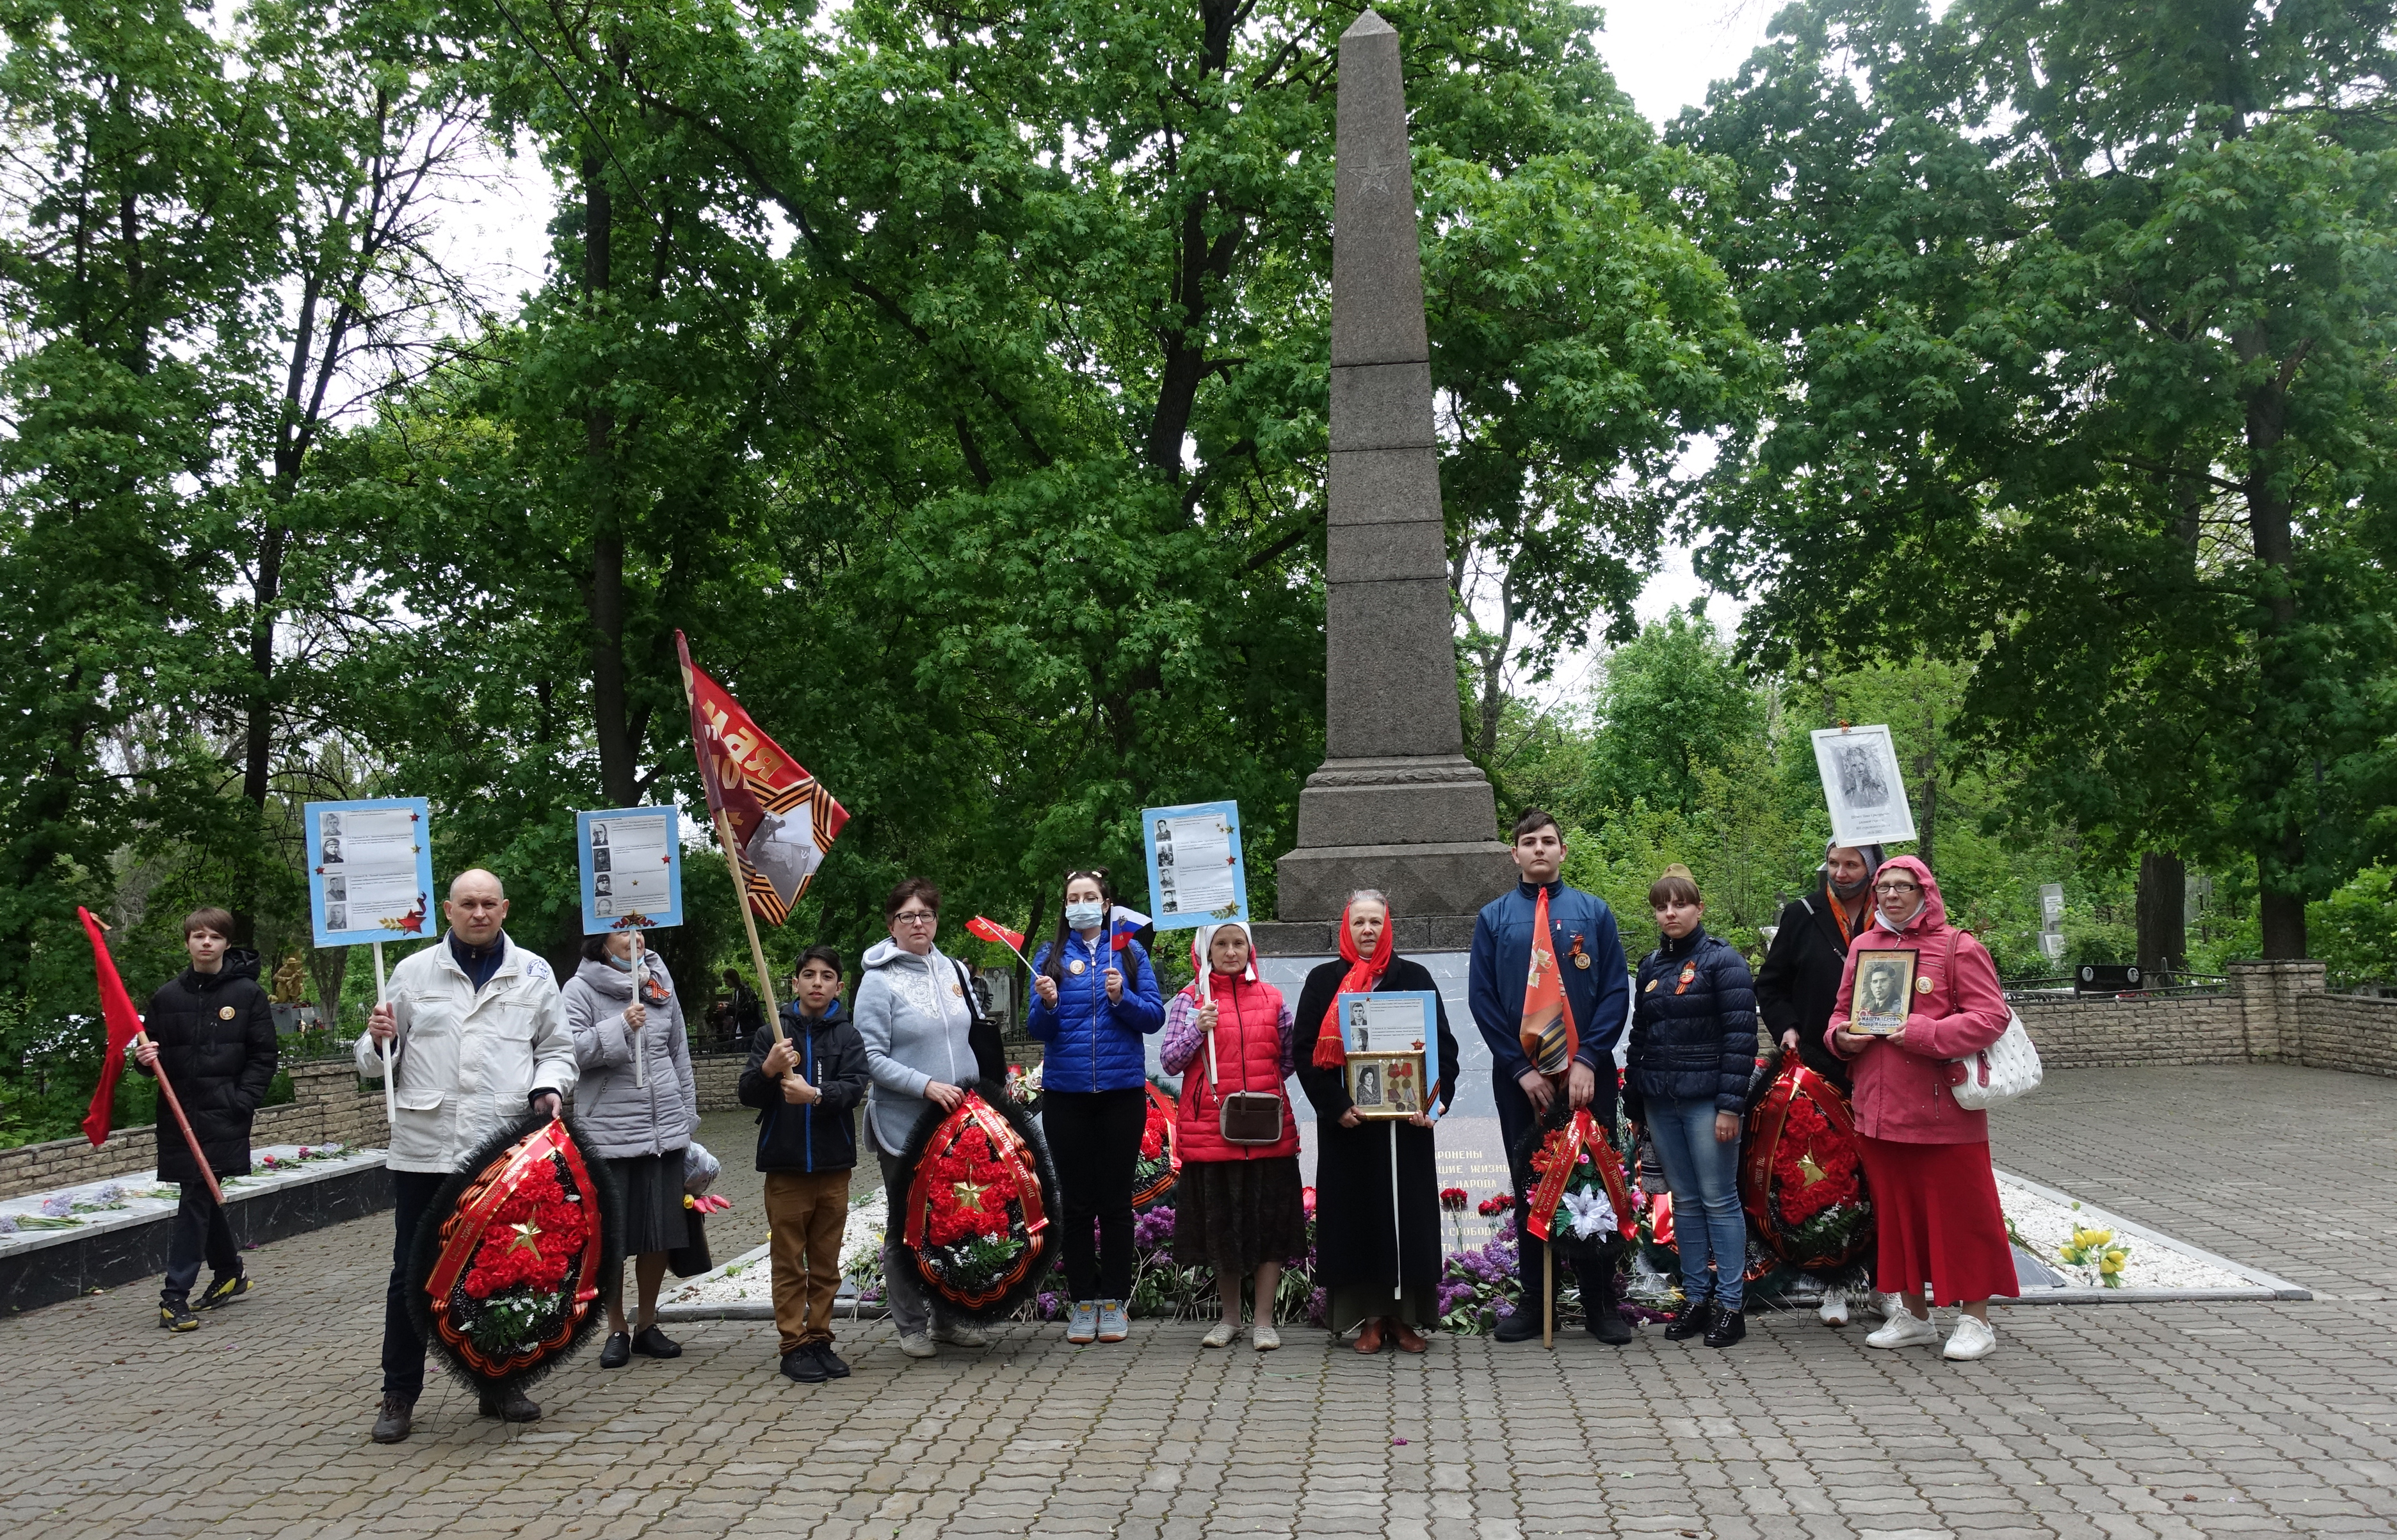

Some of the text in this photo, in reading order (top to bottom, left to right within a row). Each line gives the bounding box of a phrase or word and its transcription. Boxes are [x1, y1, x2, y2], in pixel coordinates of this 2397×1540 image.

[1014, 1159, 1035, 1198] Ростова
[1436, 1164, 1510, 1173] ШИЕ ЖИЗНЬ
[477, 1182, 503, 1216] народного
[502, 1153, 531, 1183] ополчения
[1456, 1179, 1497, 1189] НАРОДА
